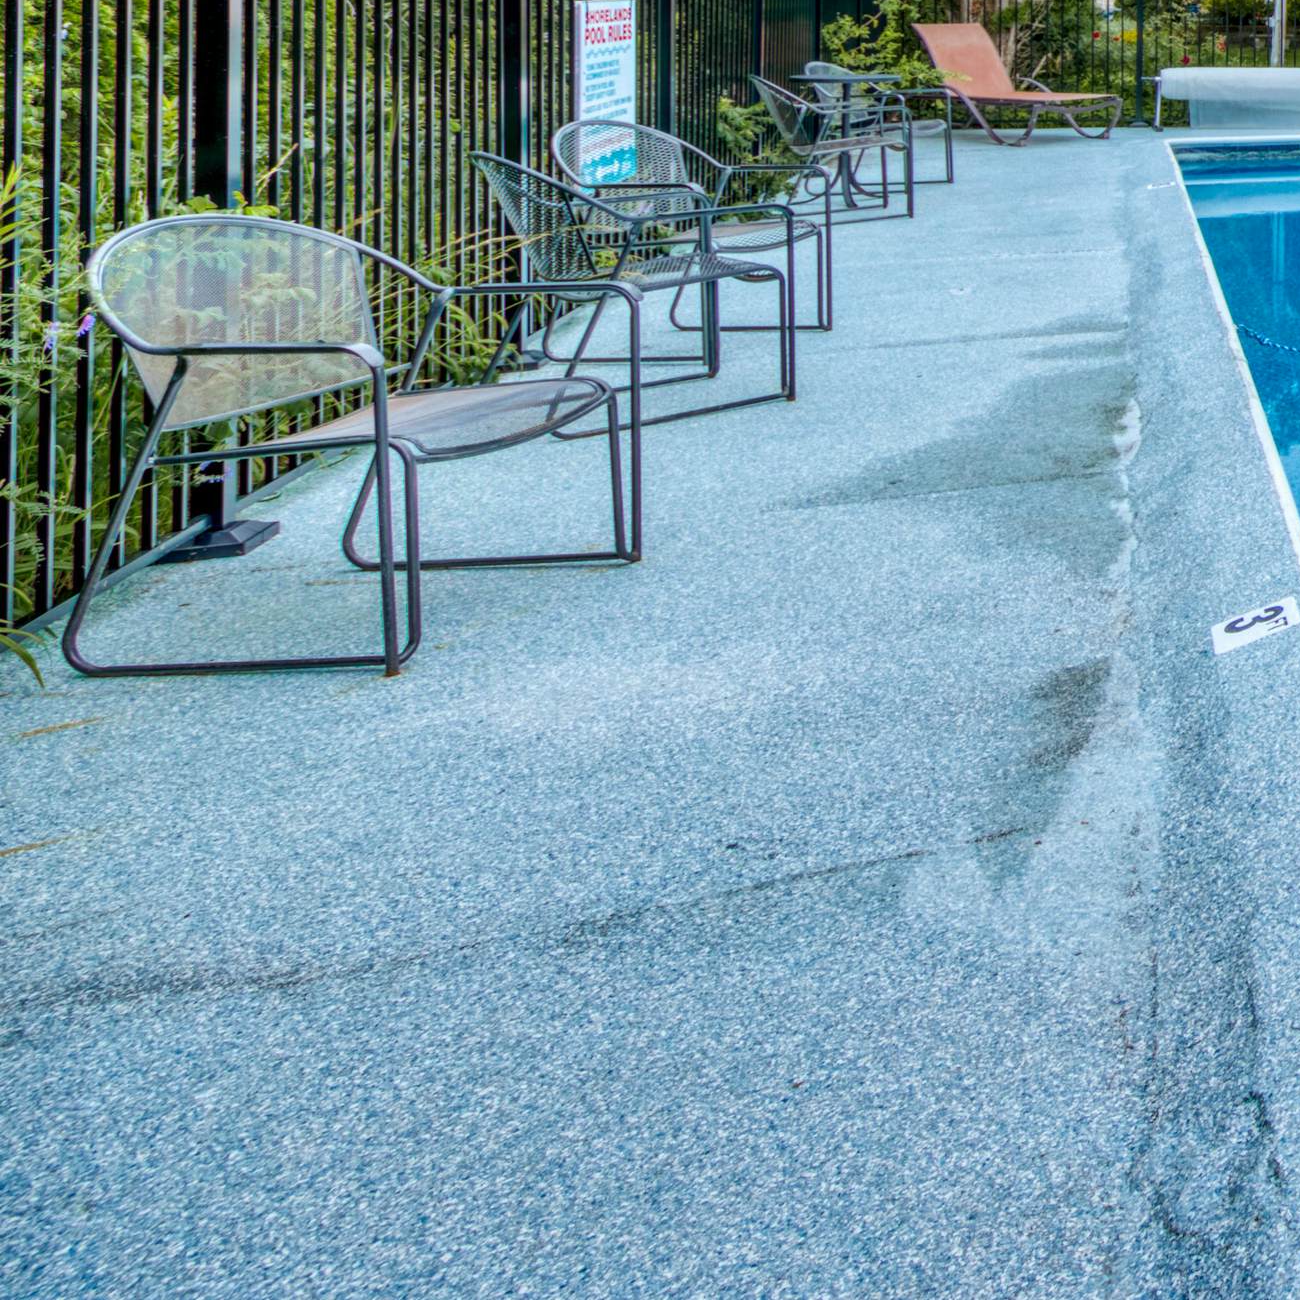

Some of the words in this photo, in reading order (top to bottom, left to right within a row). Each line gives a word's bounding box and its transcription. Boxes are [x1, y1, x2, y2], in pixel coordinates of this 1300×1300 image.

[585, 7, 632, 24] SHORELANDS
[585, 27, 605, 45] POOL
[608, 24, 632, 43] RULES
[1224, 605, 1284, 633] 3
